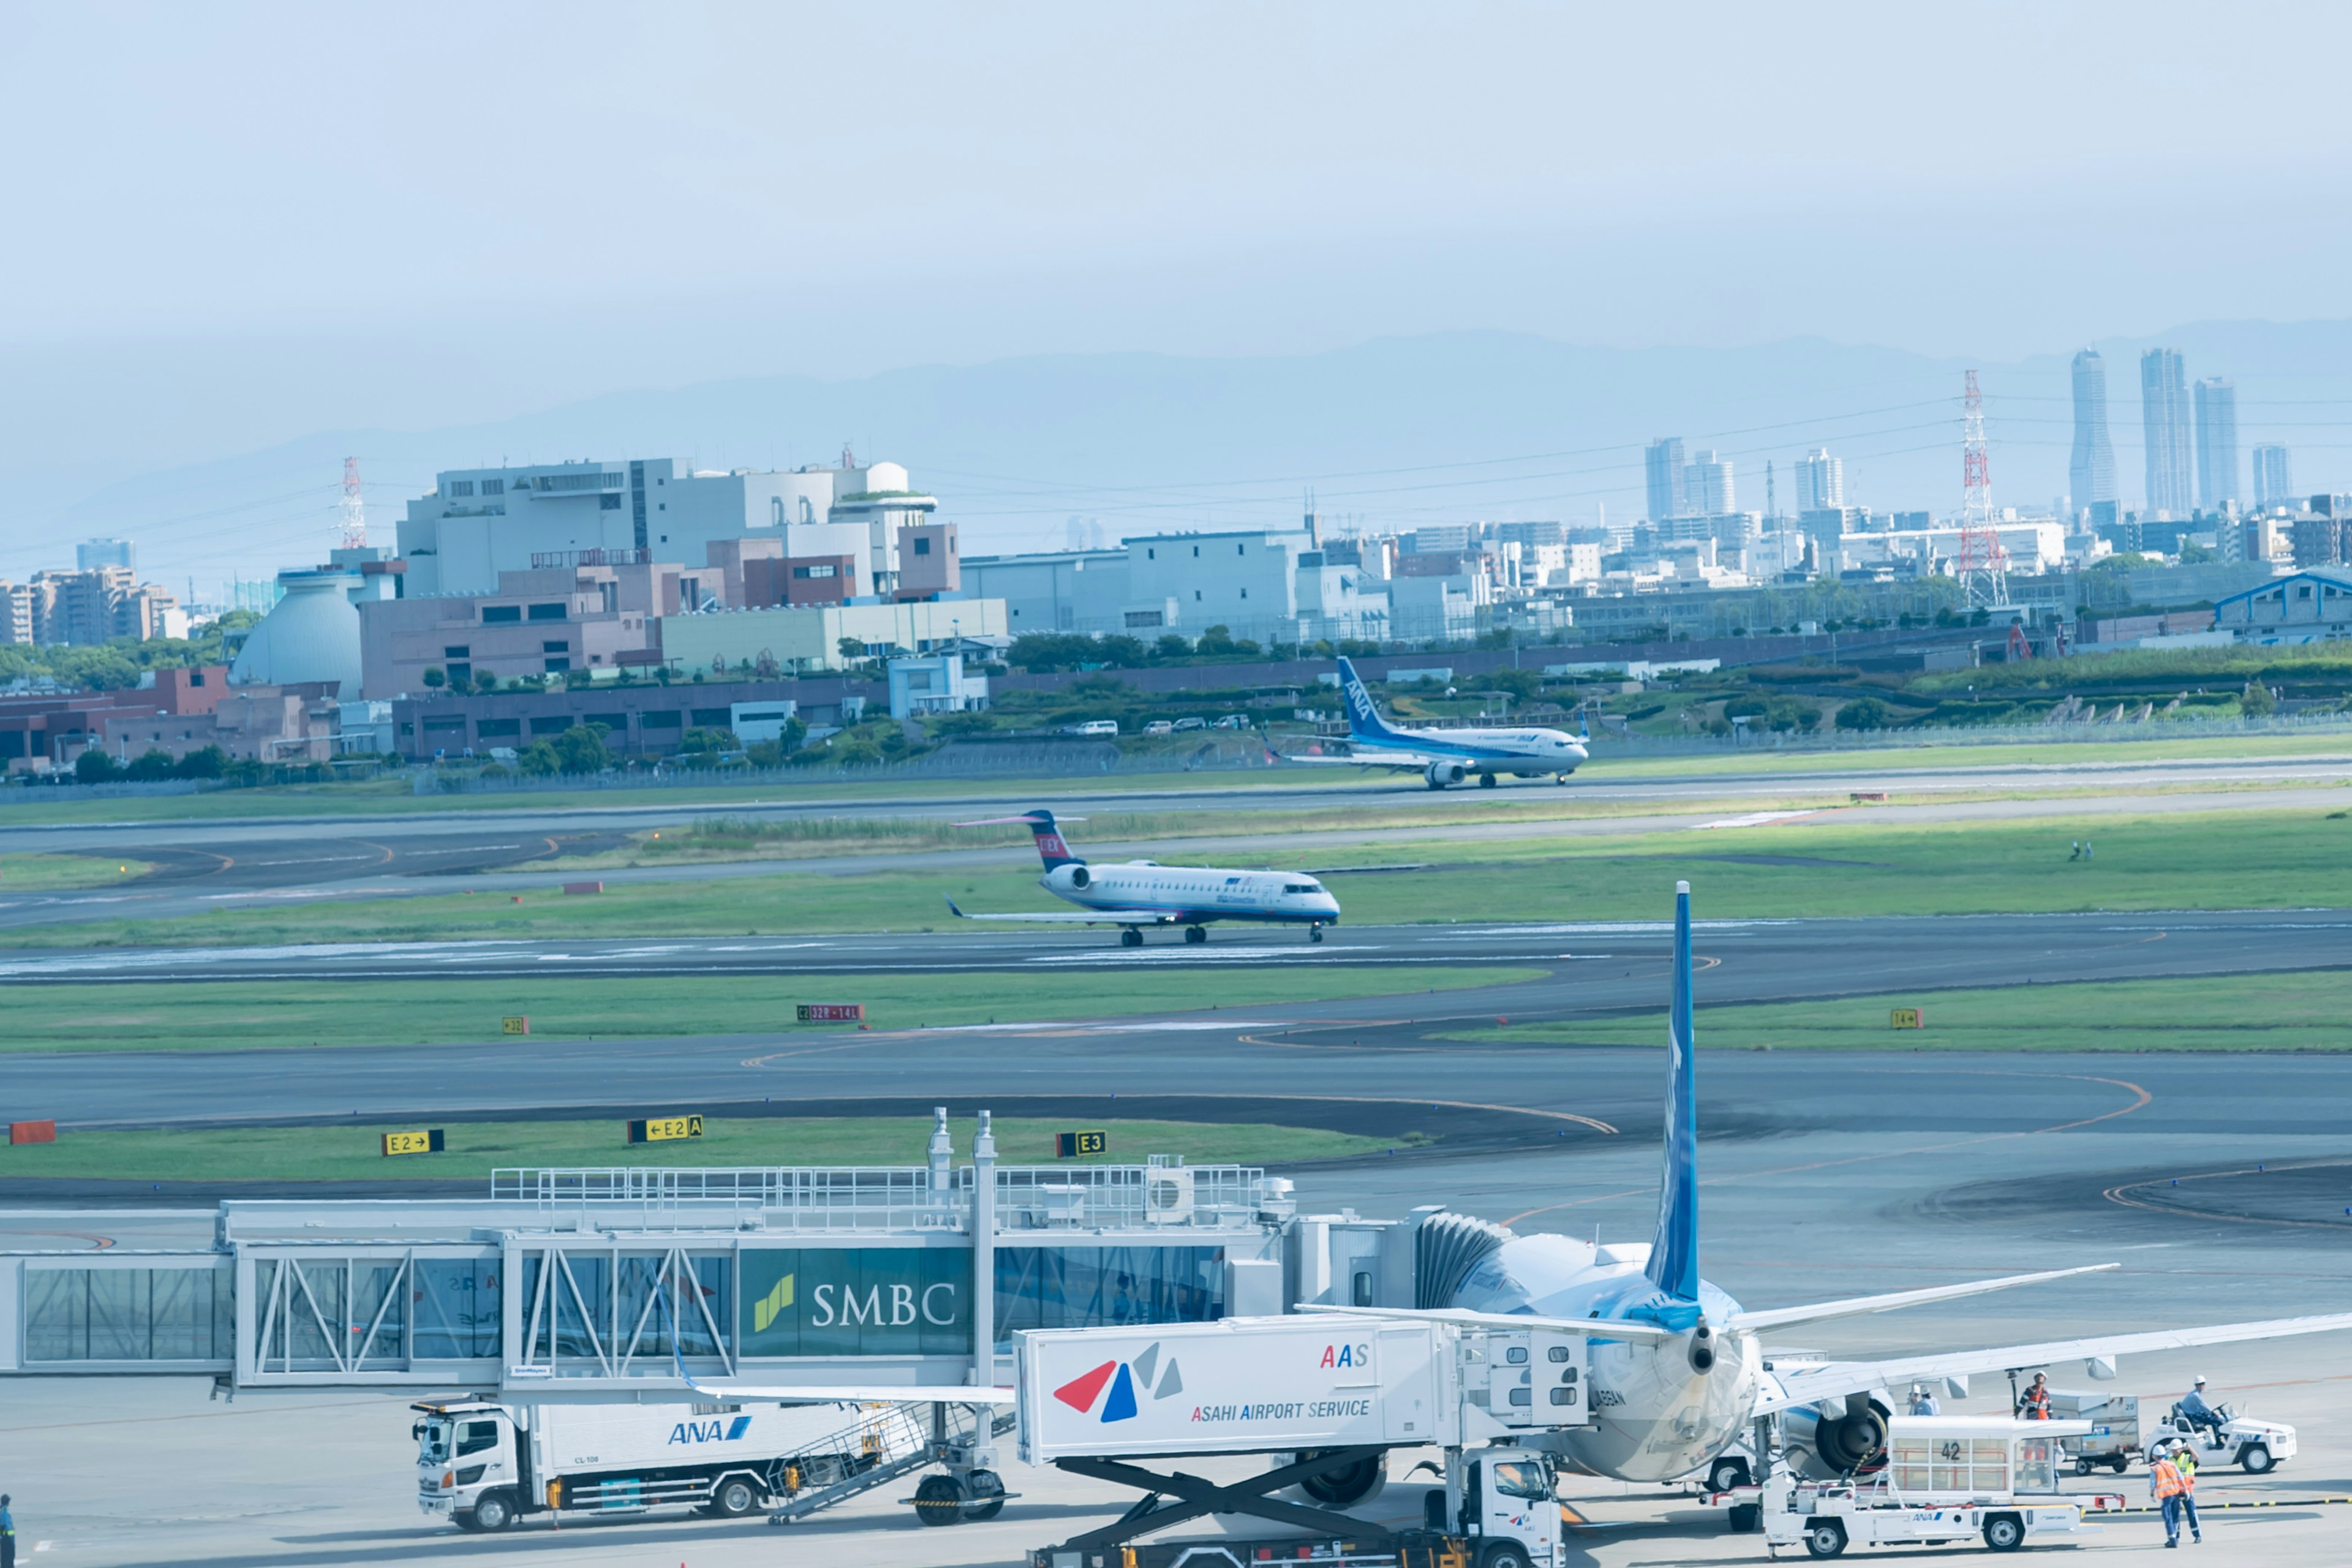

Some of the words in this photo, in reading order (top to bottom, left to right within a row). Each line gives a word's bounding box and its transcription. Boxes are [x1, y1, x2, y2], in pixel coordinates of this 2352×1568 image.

[1345, 680, 1370, 721] ANA
[691, 1119, 701, 1134] A
[391, 1137, 410, 1151] E2
[1081, 1135, 1101, 1151] E3
[812, 1283, 956, 1327] SMBC
[1320, 1343, 1369, 1369] AAS
[1191, 1406, 1237, 1422] ASAHI
[1240, 1403, 1304, 1420] AIRPORT
[1308, 1400, 1370, 1417] SERVICE
[668, 1420, 723, 1444] ANA
[1942, 1442, 1960, 1460] 42
[1913, 1513, 1932, 1521] ANA
